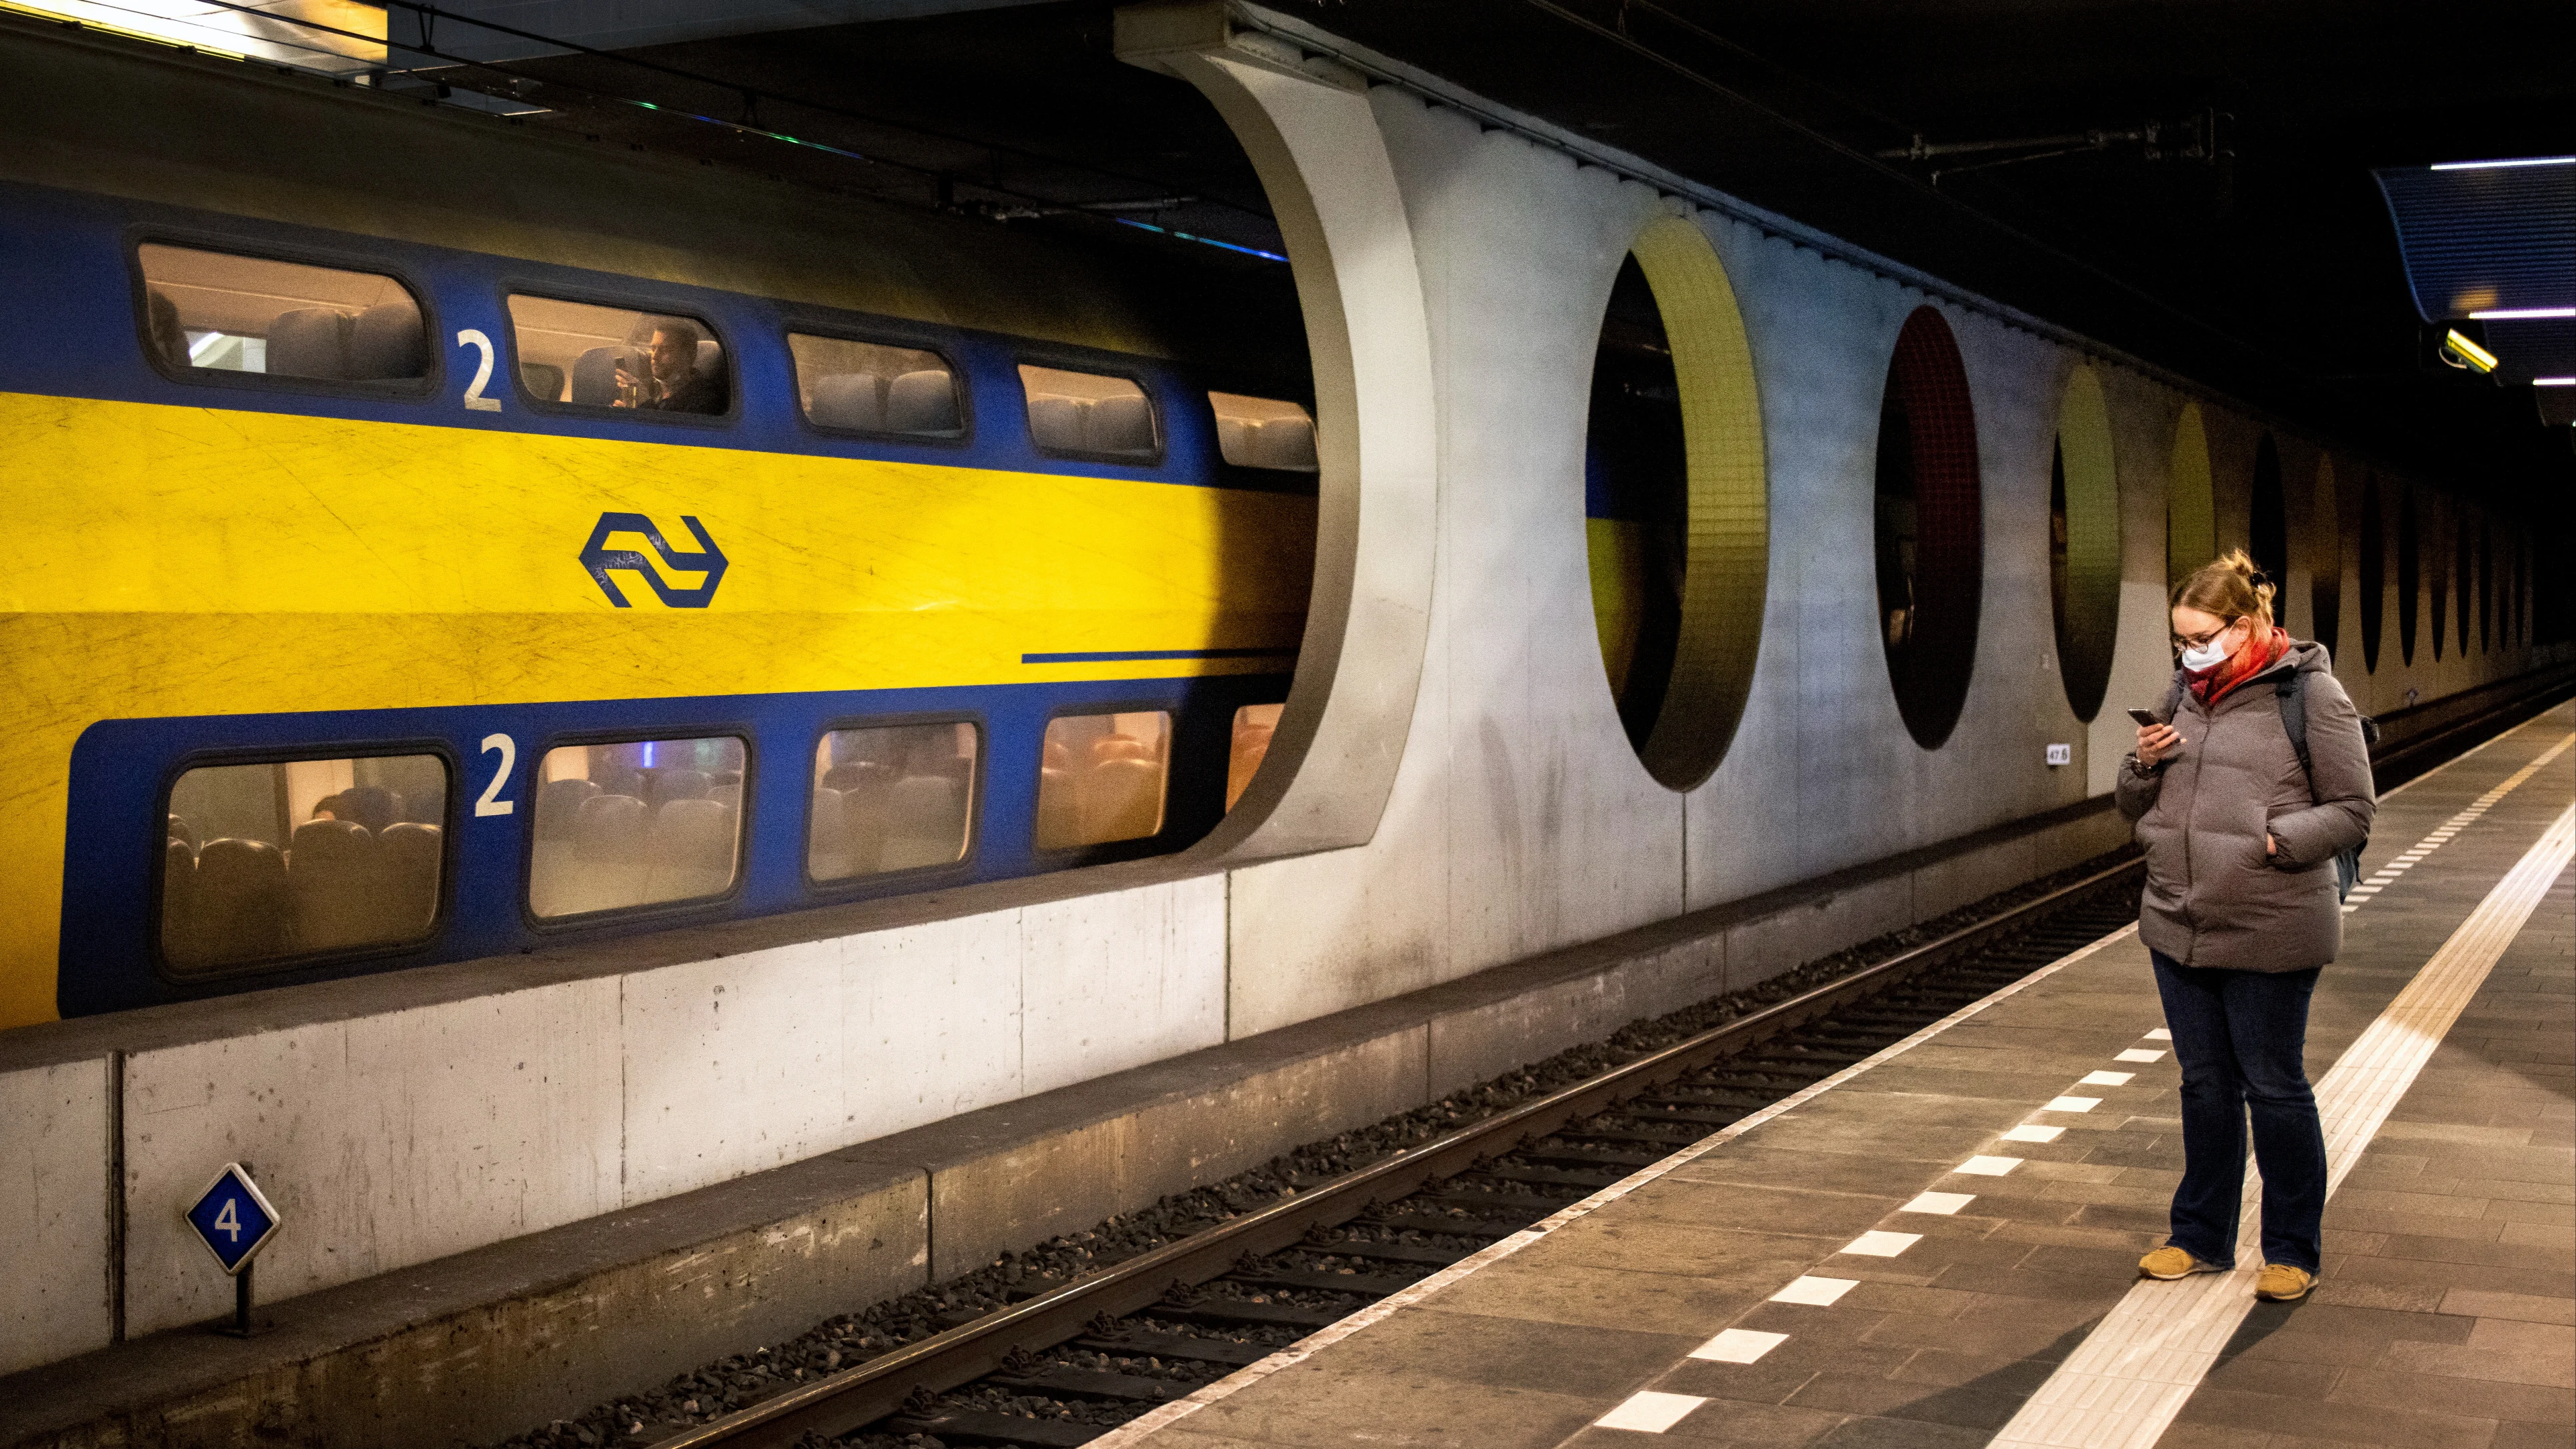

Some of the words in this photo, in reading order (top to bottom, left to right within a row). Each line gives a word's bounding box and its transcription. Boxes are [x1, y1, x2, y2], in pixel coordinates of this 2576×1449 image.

[457, 328, 502, 413] 2
[475, 733, 515, 817] 2
[215, 1197, 241, 1242] 4
